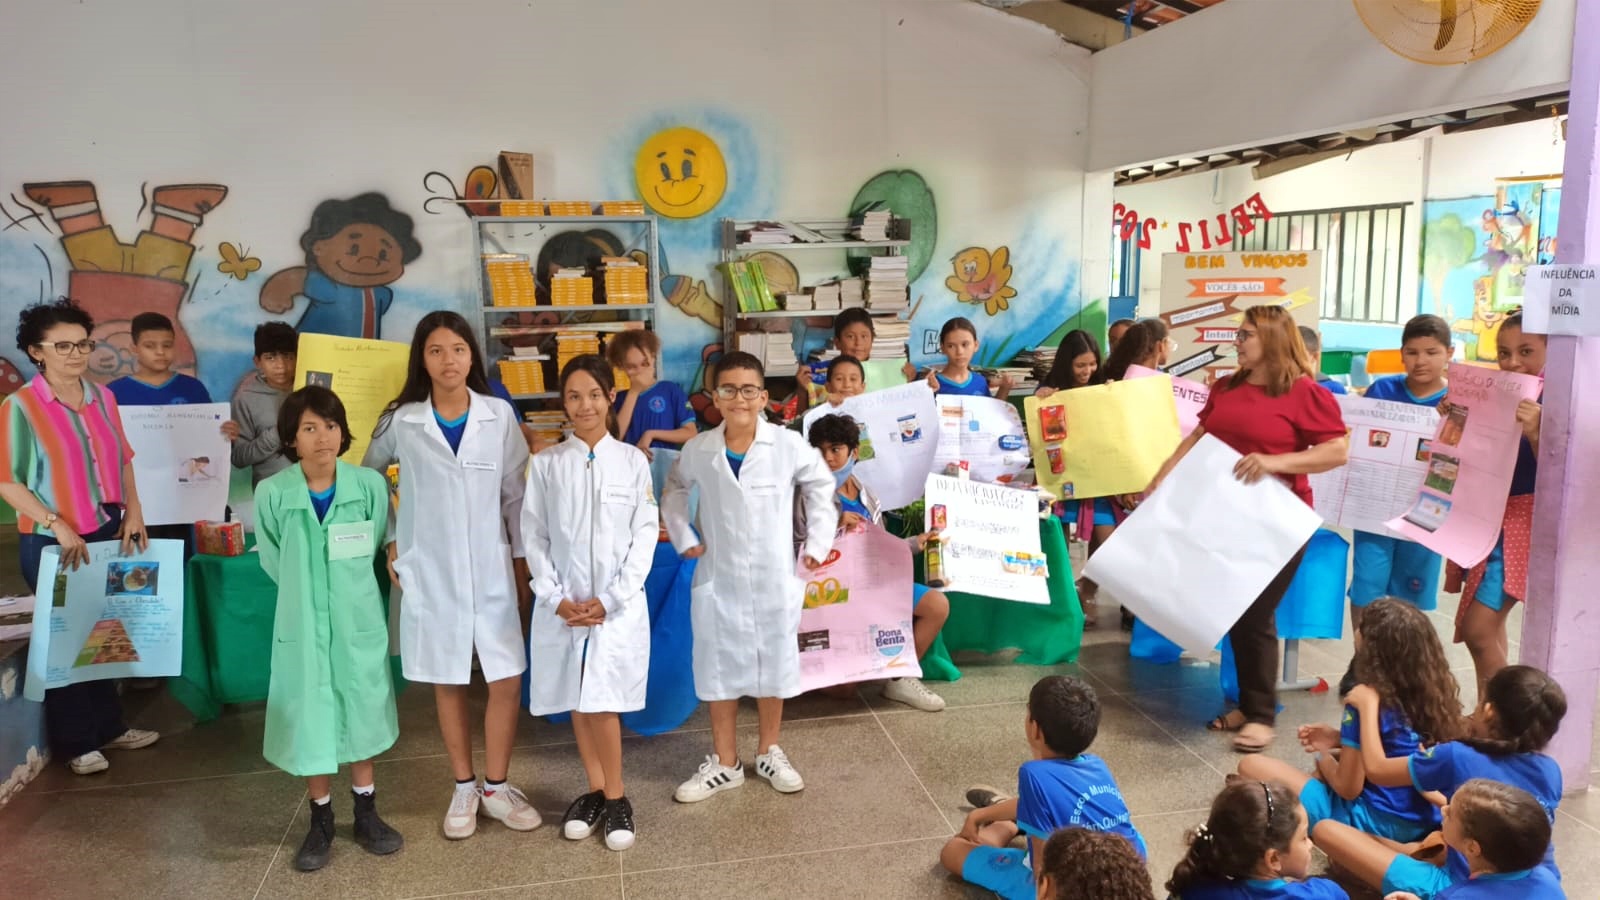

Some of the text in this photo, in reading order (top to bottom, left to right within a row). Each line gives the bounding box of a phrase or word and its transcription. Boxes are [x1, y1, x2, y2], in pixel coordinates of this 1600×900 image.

[1184, 253, 1308, 269] BEM VINDOS
[1540, 267, 1595, 279] INFLUÊNCIA
[1558, 288, 1572, 297] DA
[1551, 303, 1580, 315] MÍDIA
[878, 629, 902, 639] Dona
[875, 635, 905, 648] Benta
